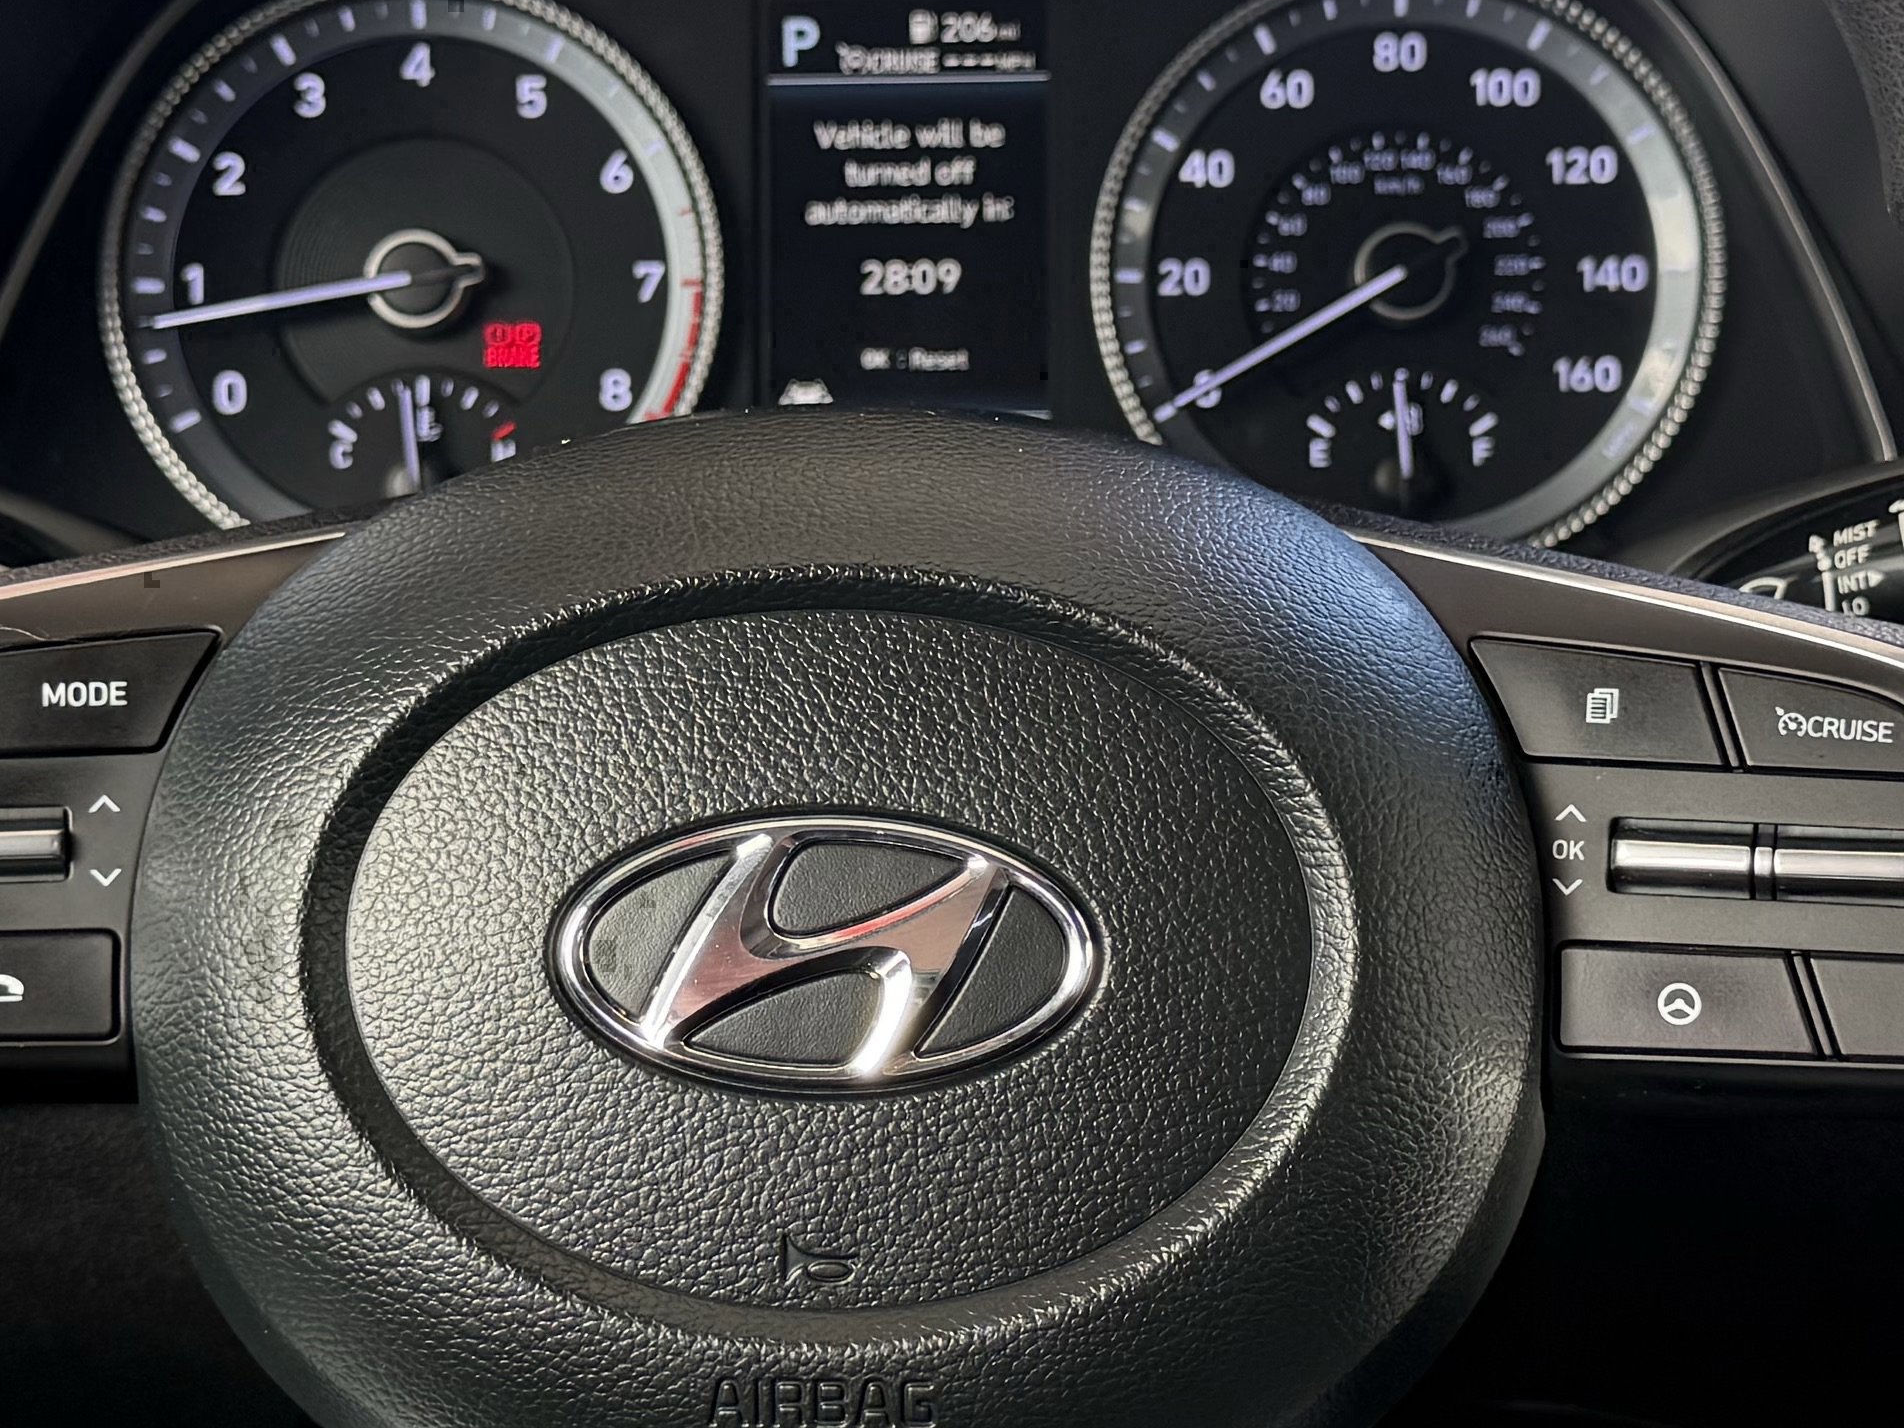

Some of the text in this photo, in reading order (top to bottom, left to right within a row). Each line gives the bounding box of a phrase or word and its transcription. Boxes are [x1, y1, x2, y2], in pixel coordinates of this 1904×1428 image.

[782, 15, 820, 68] P
[1372, 32, 1428, 72] 80
[400, 43, 436, 88] 4
[295, 72, 327, 119] 3
[514, 73, 548, 119] 5
[1259, 68, 1315, 109] 60
[1470, 68, 1541, 108] 100
[813, 117, 1006, 150] Vehicle will be
[212, 151, 247, 197] 2
[600, 150, 634, 196] 6
[844, 155, 976, 187] turned off
[1178, 148, 1235, 188] 40
[1546, 145, 1619, 186] 120
[805, 193, 979, 229] automatically
[180, 263, 206, 304] 1
[631, 261, 666, 303] 7
[860, 257, 962, 295] 28:09
[1157, 258, 1211, 297] 20
[1577, 254, 1650, 294] 140
[212, 371, 247, 416] 0
[599, 369, 634, 413] 8
[1553, 354, 1623, 393] 160
[329, 438, 354, 469] C
[1309, 437, 1332, 468] E
[1472, 436, 1495, 467] F
[1833, 519, 1879, 547] MIST
[1834, 544, 1872, 570] OFF
[1837, 572, 1870, 595] INT
[41, 679, 128, 708] MODE
[1807, 716, 1895, 744] CRUISE
[1552, 840, 1585, 861] OK
